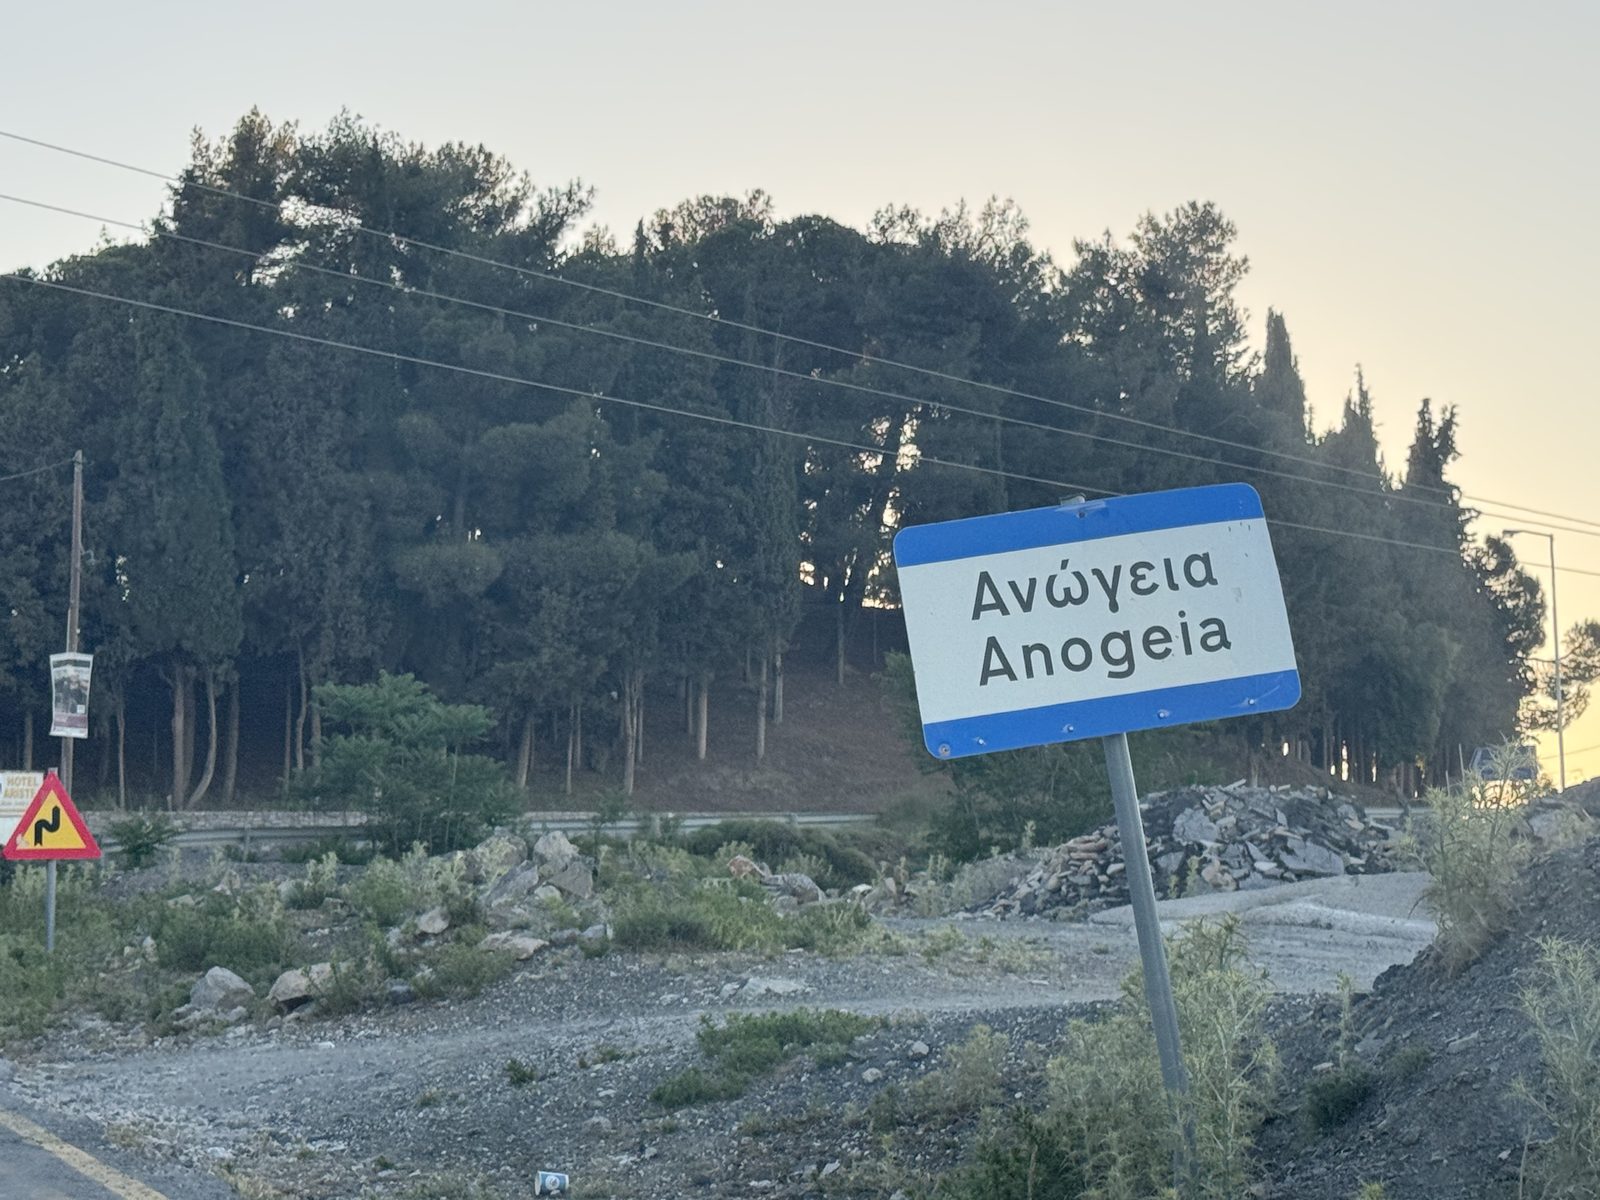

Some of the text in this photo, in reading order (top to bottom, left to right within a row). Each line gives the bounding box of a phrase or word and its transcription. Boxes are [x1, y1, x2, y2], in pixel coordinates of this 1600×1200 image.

[972, 552, 1218, 620] Ανώγεια
[979, 610, 1231, 686] Anogeia
[7, 775, 38, 786] HOTEL
